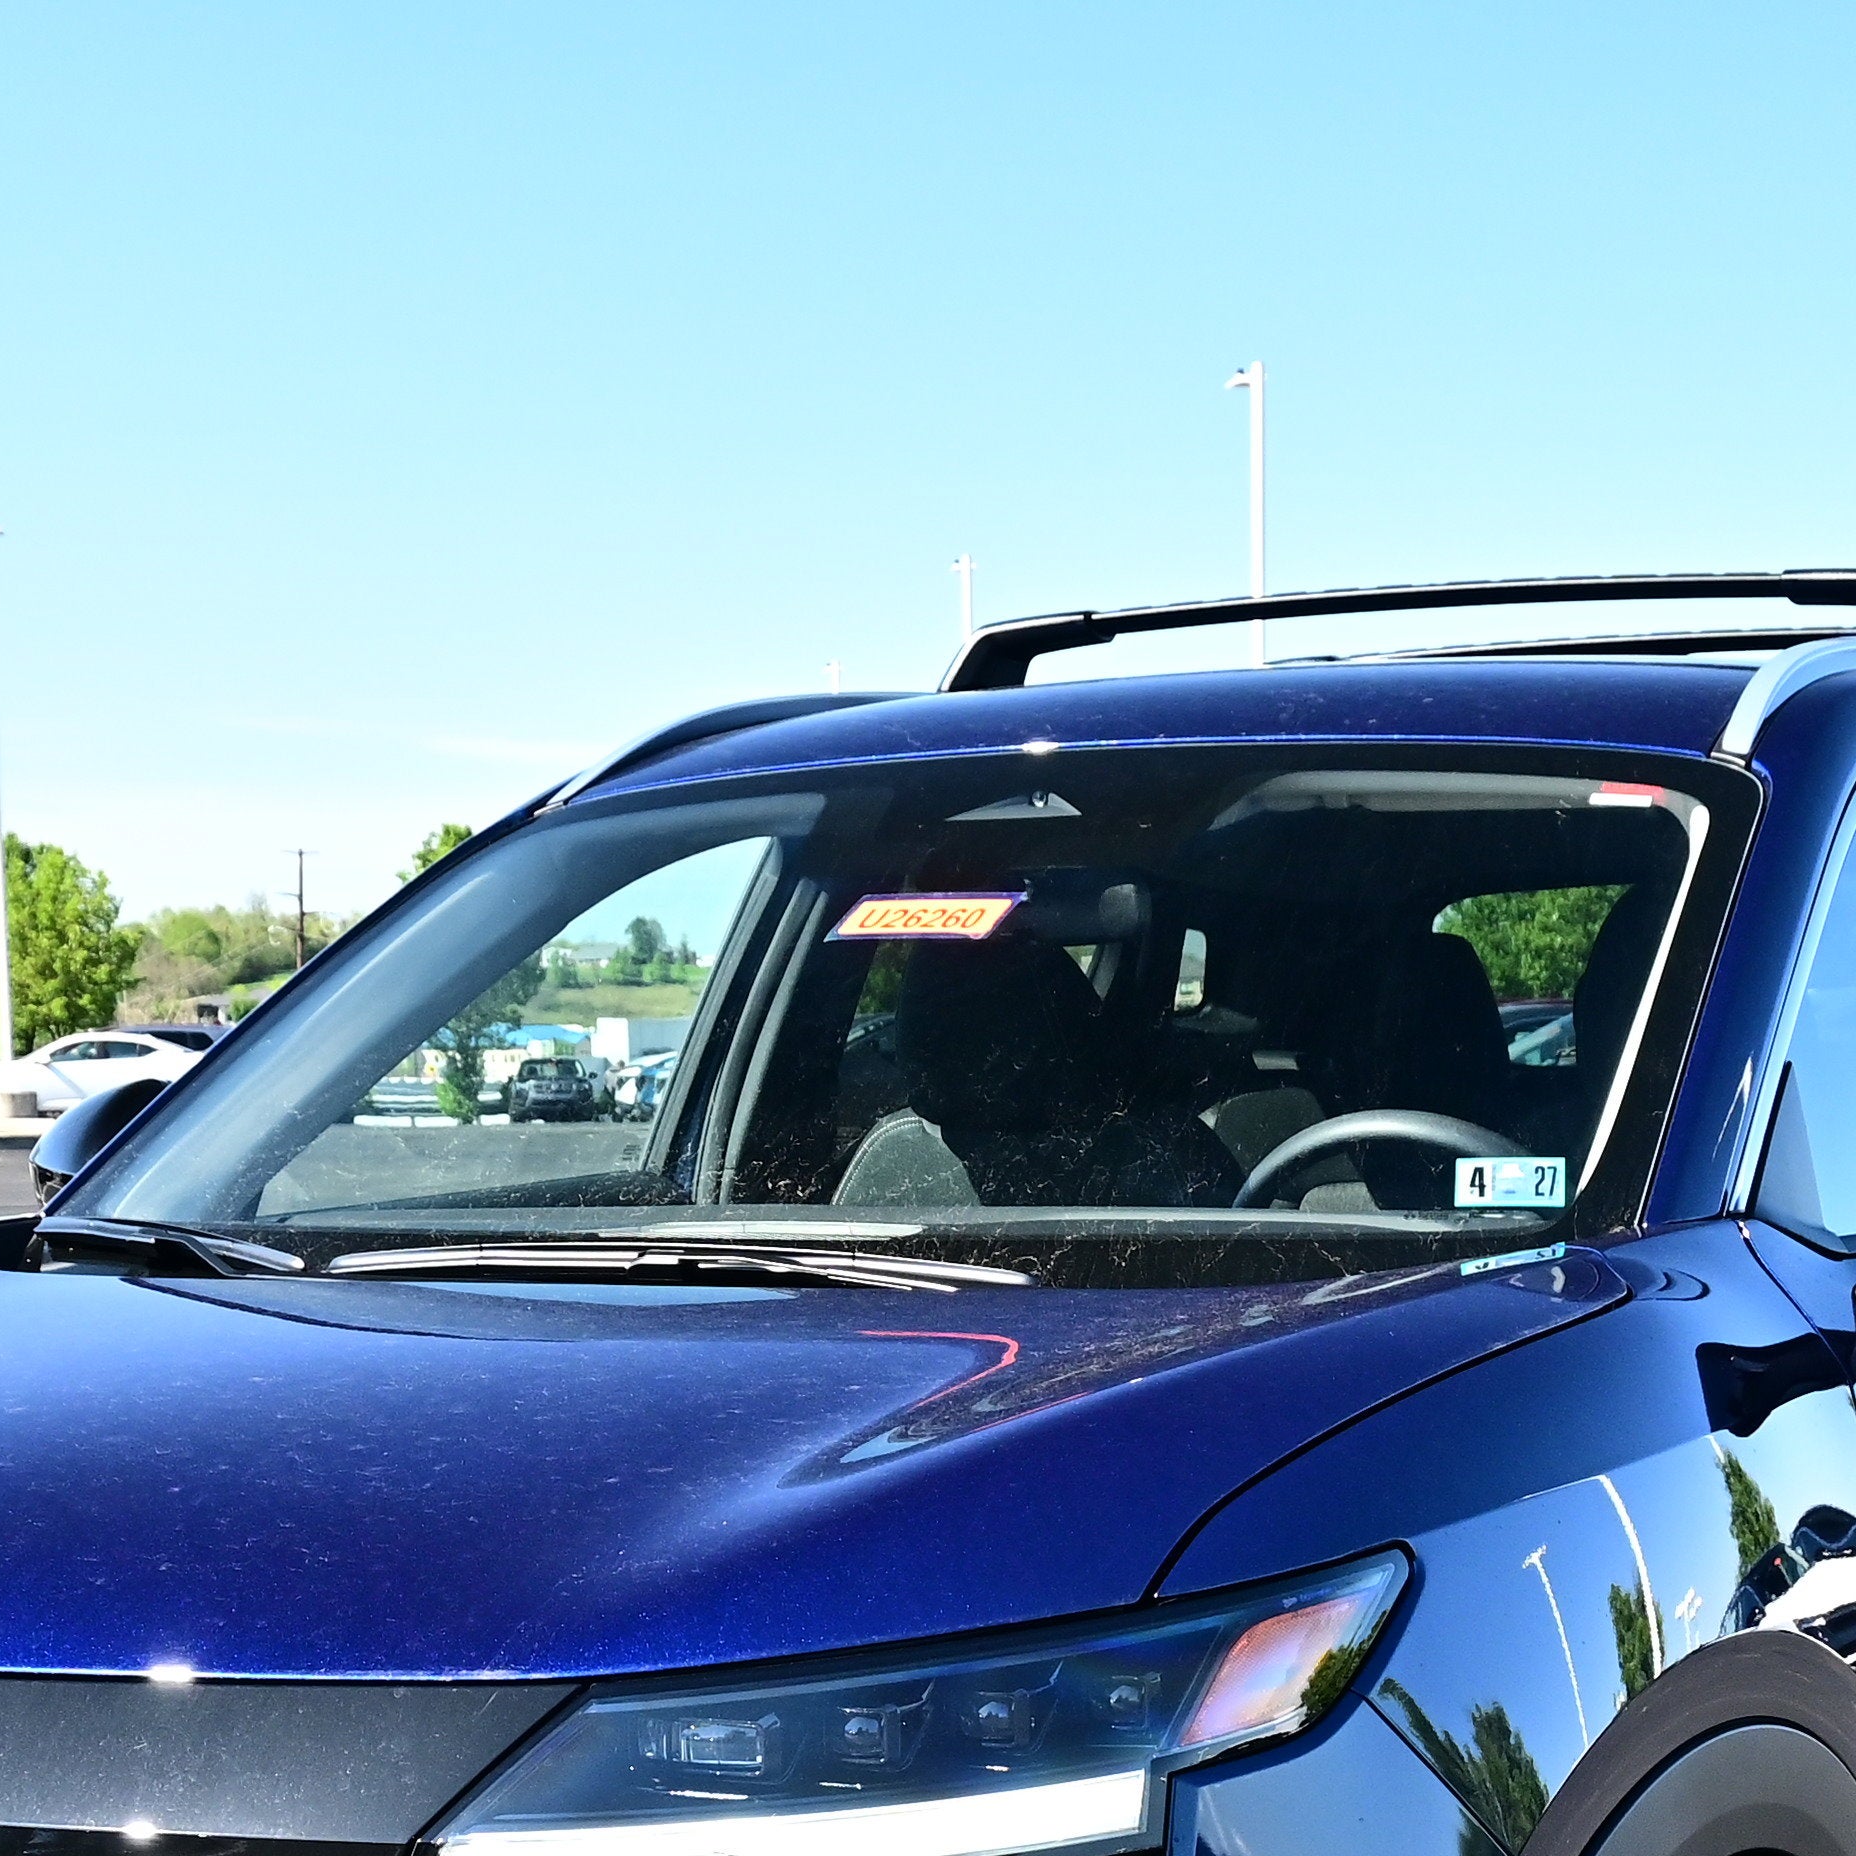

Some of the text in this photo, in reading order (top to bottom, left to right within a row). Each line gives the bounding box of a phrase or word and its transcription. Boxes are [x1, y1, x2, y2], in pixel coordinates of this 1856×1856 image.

[858, 907, 987, 929] U26260
[1469, 1166, 1487, 1198] 4
[1534, 1165, 1558, 1197] 27
